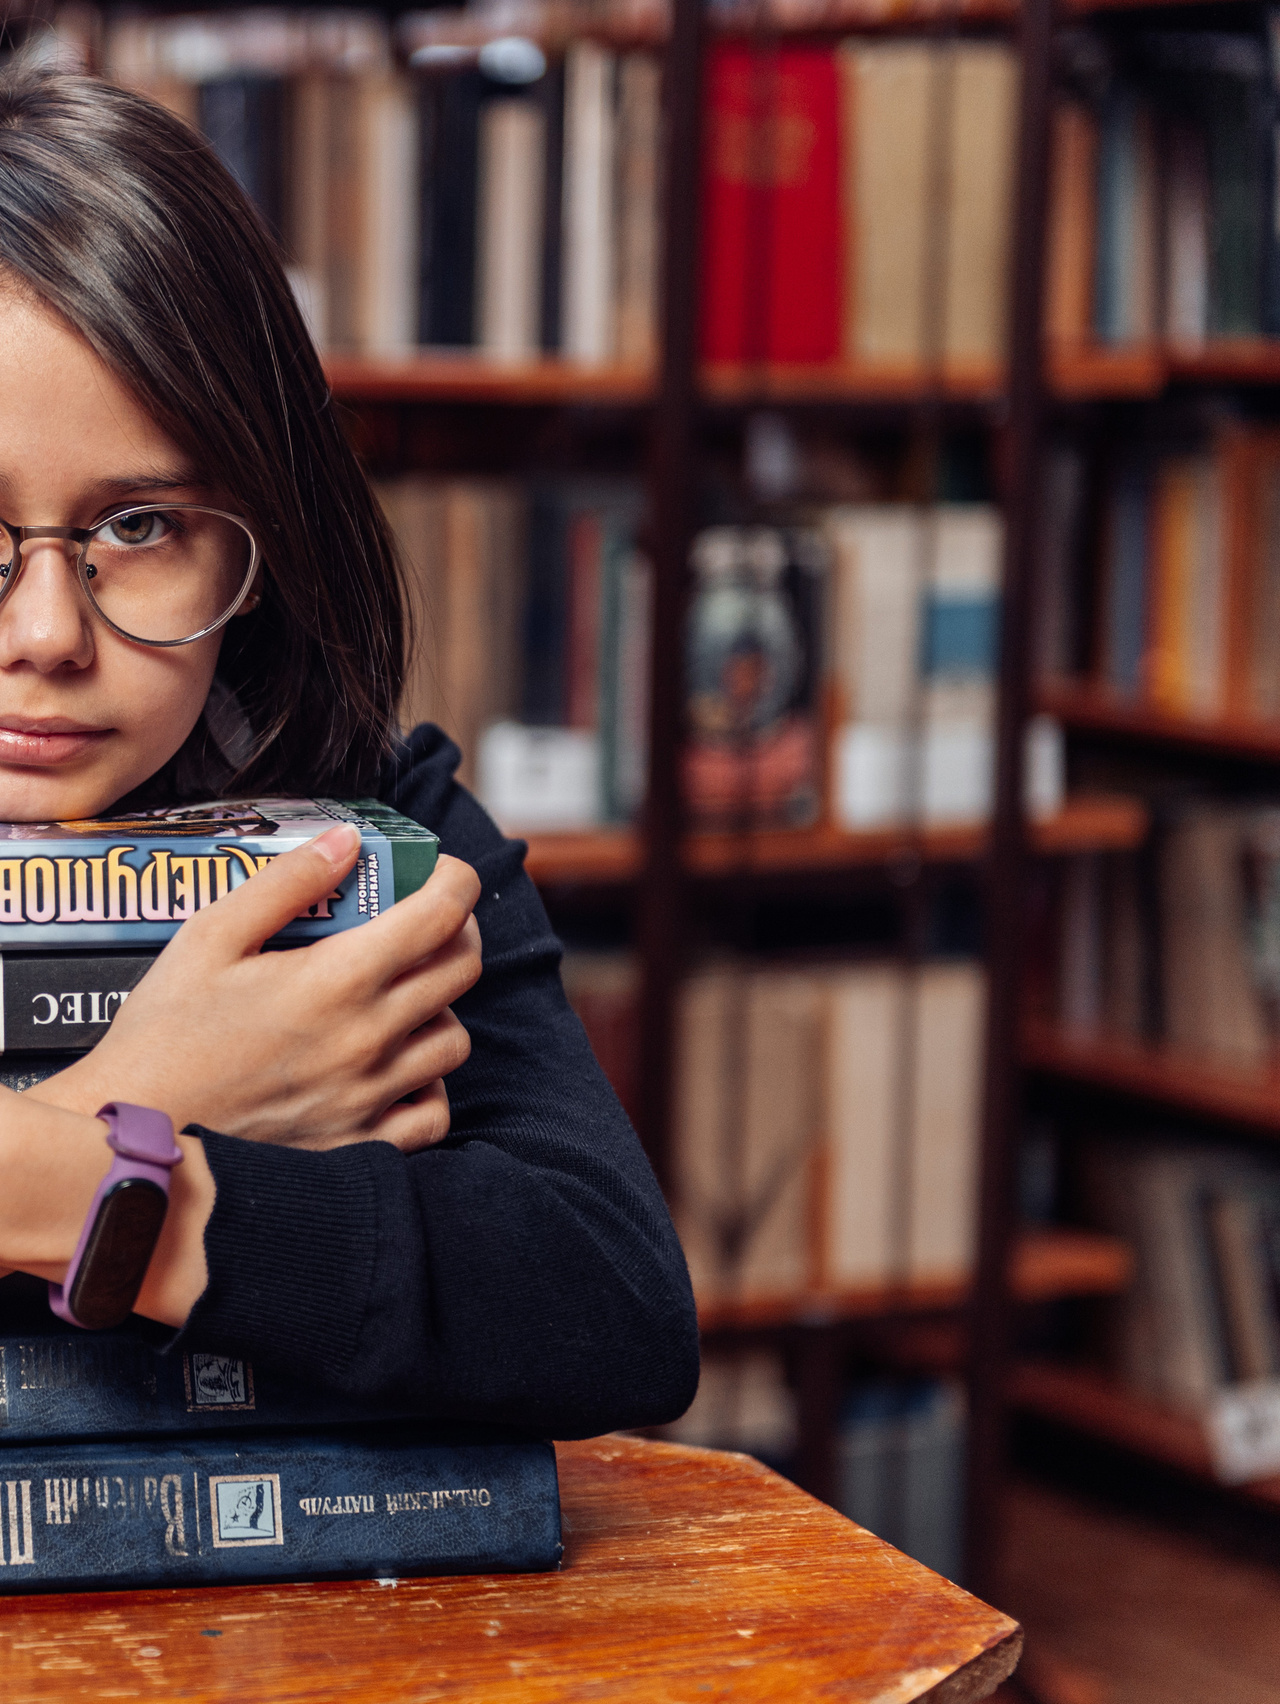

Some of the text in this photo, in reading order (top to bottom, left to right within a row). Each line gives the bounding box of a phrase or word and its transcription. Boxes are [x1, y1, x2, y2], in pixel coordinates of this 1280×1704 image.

[357, 859, 368, 915] ХРОНИКИ
[32, 991, 131, 1025] ЛЕС
[299, 1494, 375, 1516] ПАТРУЛЬ
